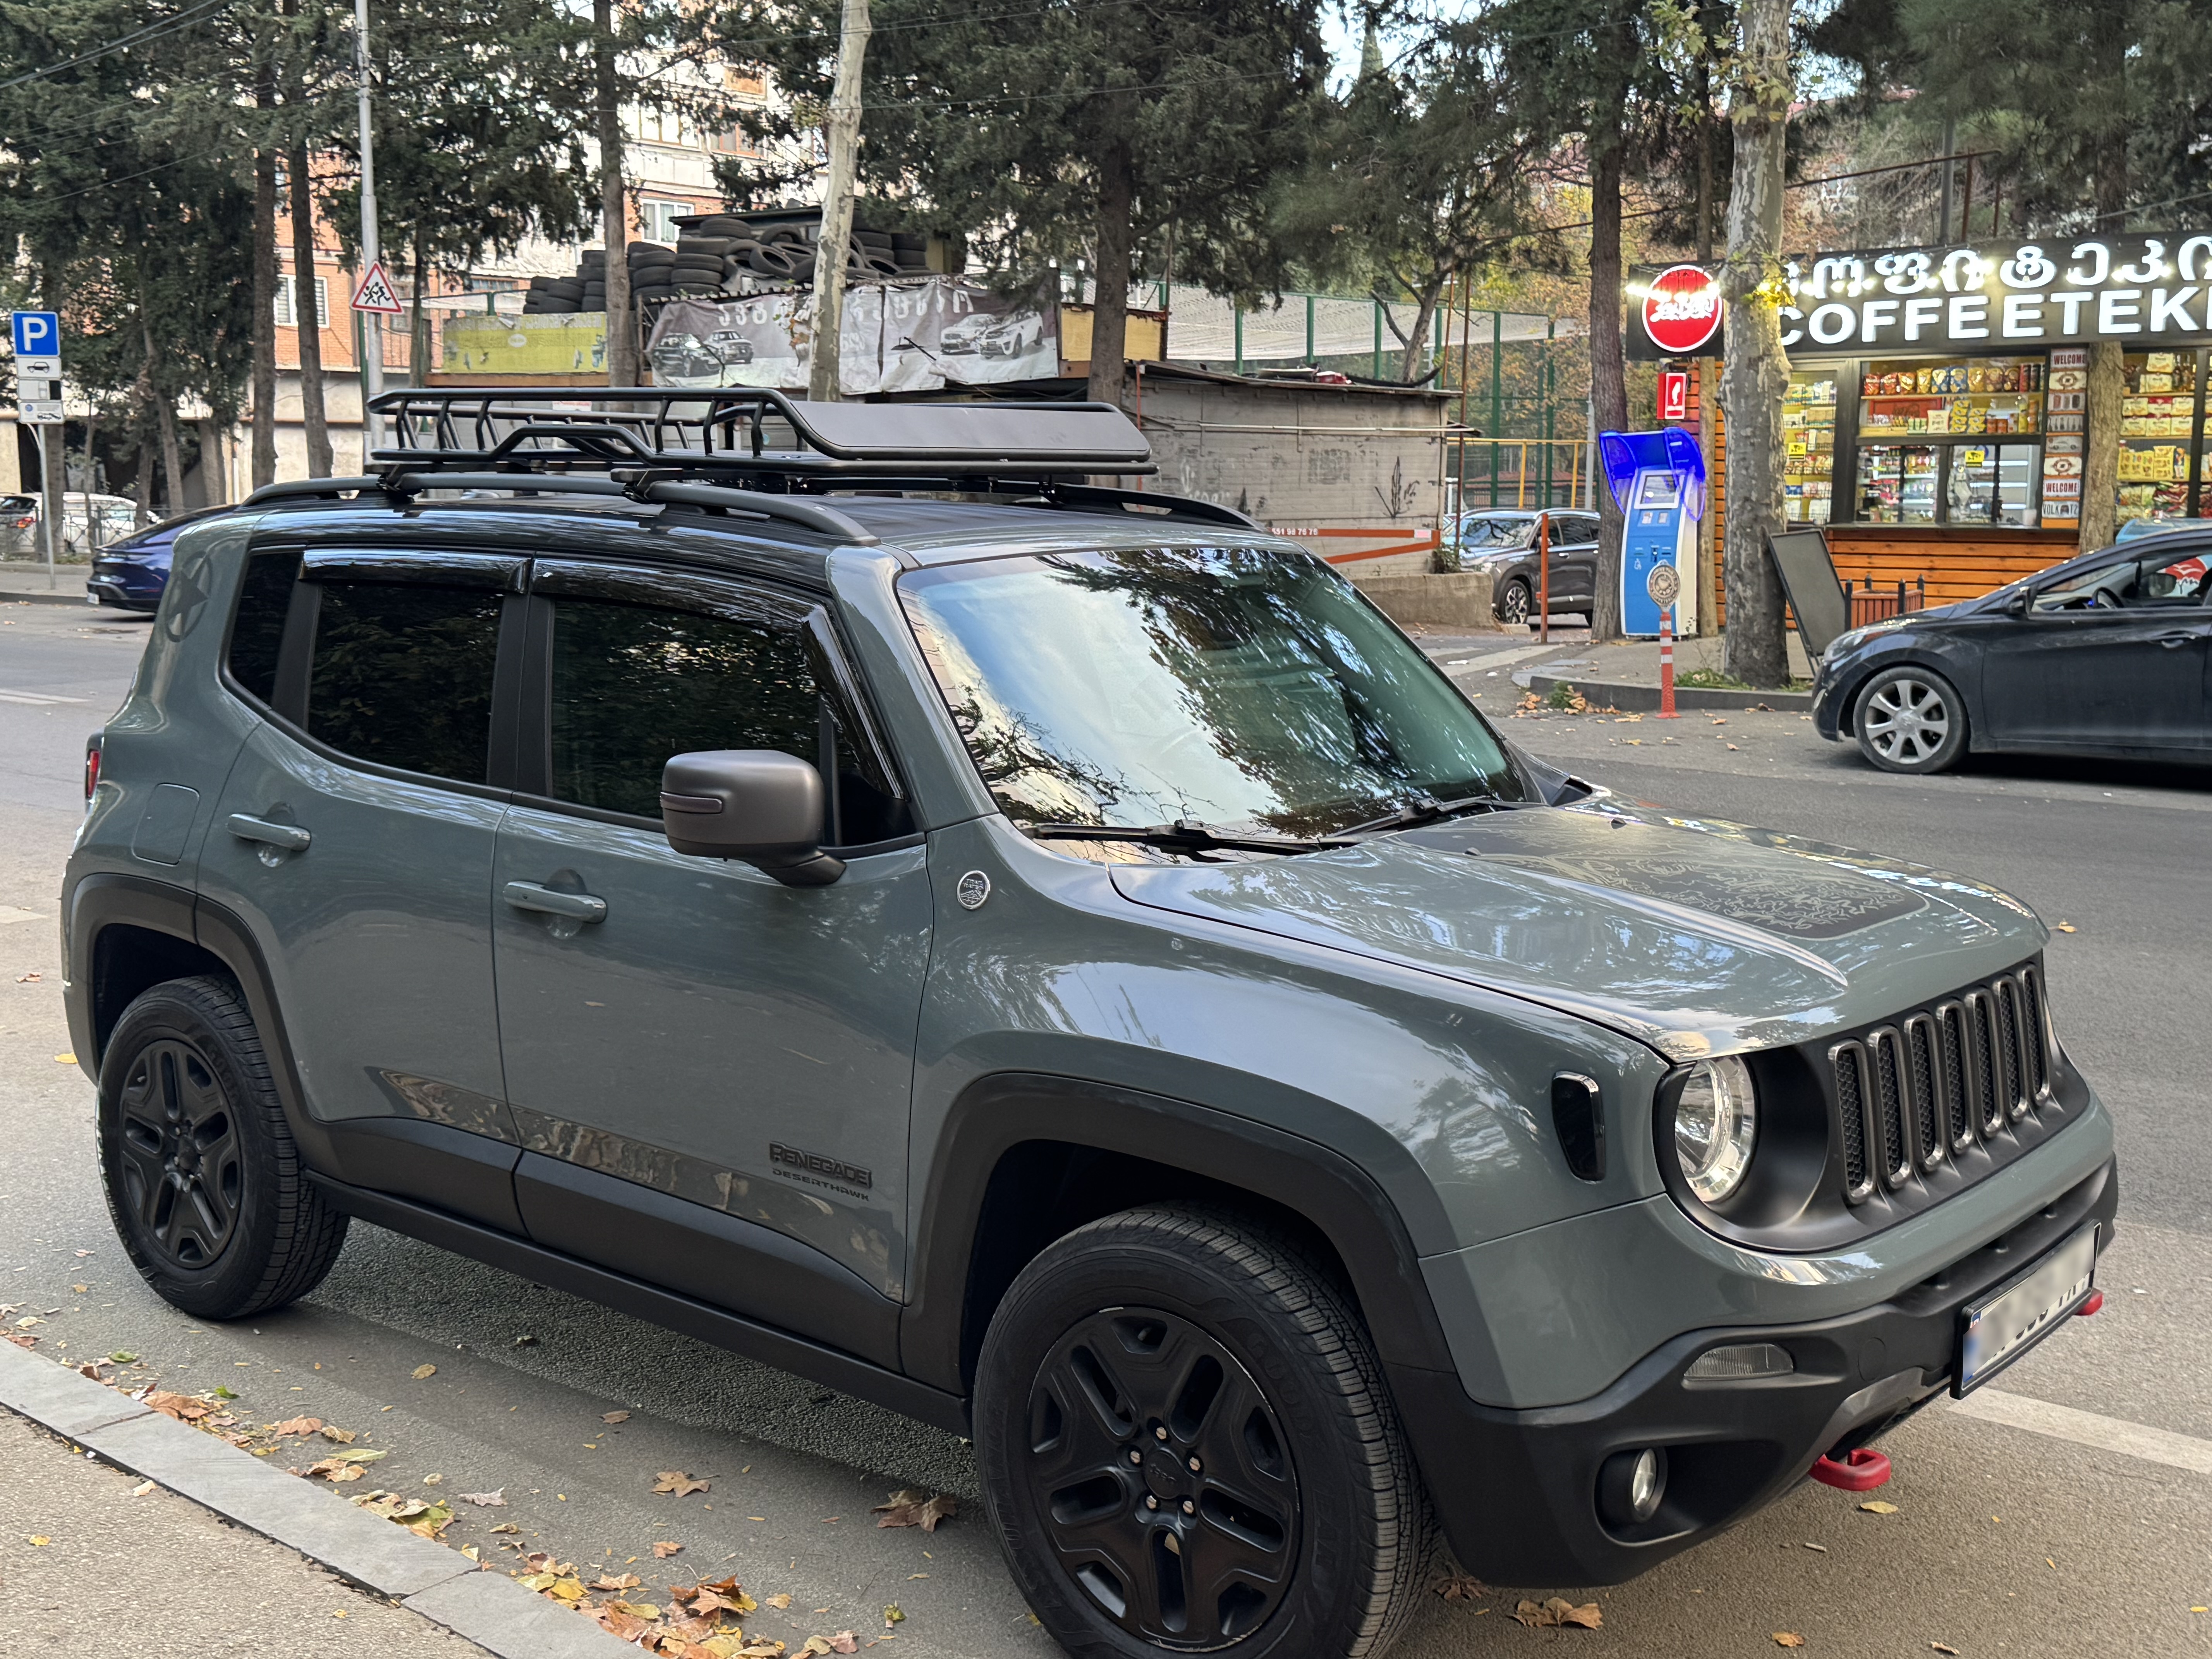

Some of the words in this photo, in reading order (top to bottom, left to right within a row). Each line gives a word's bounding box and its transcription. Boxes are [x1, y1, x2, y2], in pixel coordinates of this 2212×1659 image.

[22, 317, 48, 352] P
[2054, 354, 2086, 365] WELCOME
[2046, 483, 2077, 493] WELCOME
[769, 1141, 872, 1188] RENEGADE
[772, 1168, 870, 1202] DESERTHAWK
